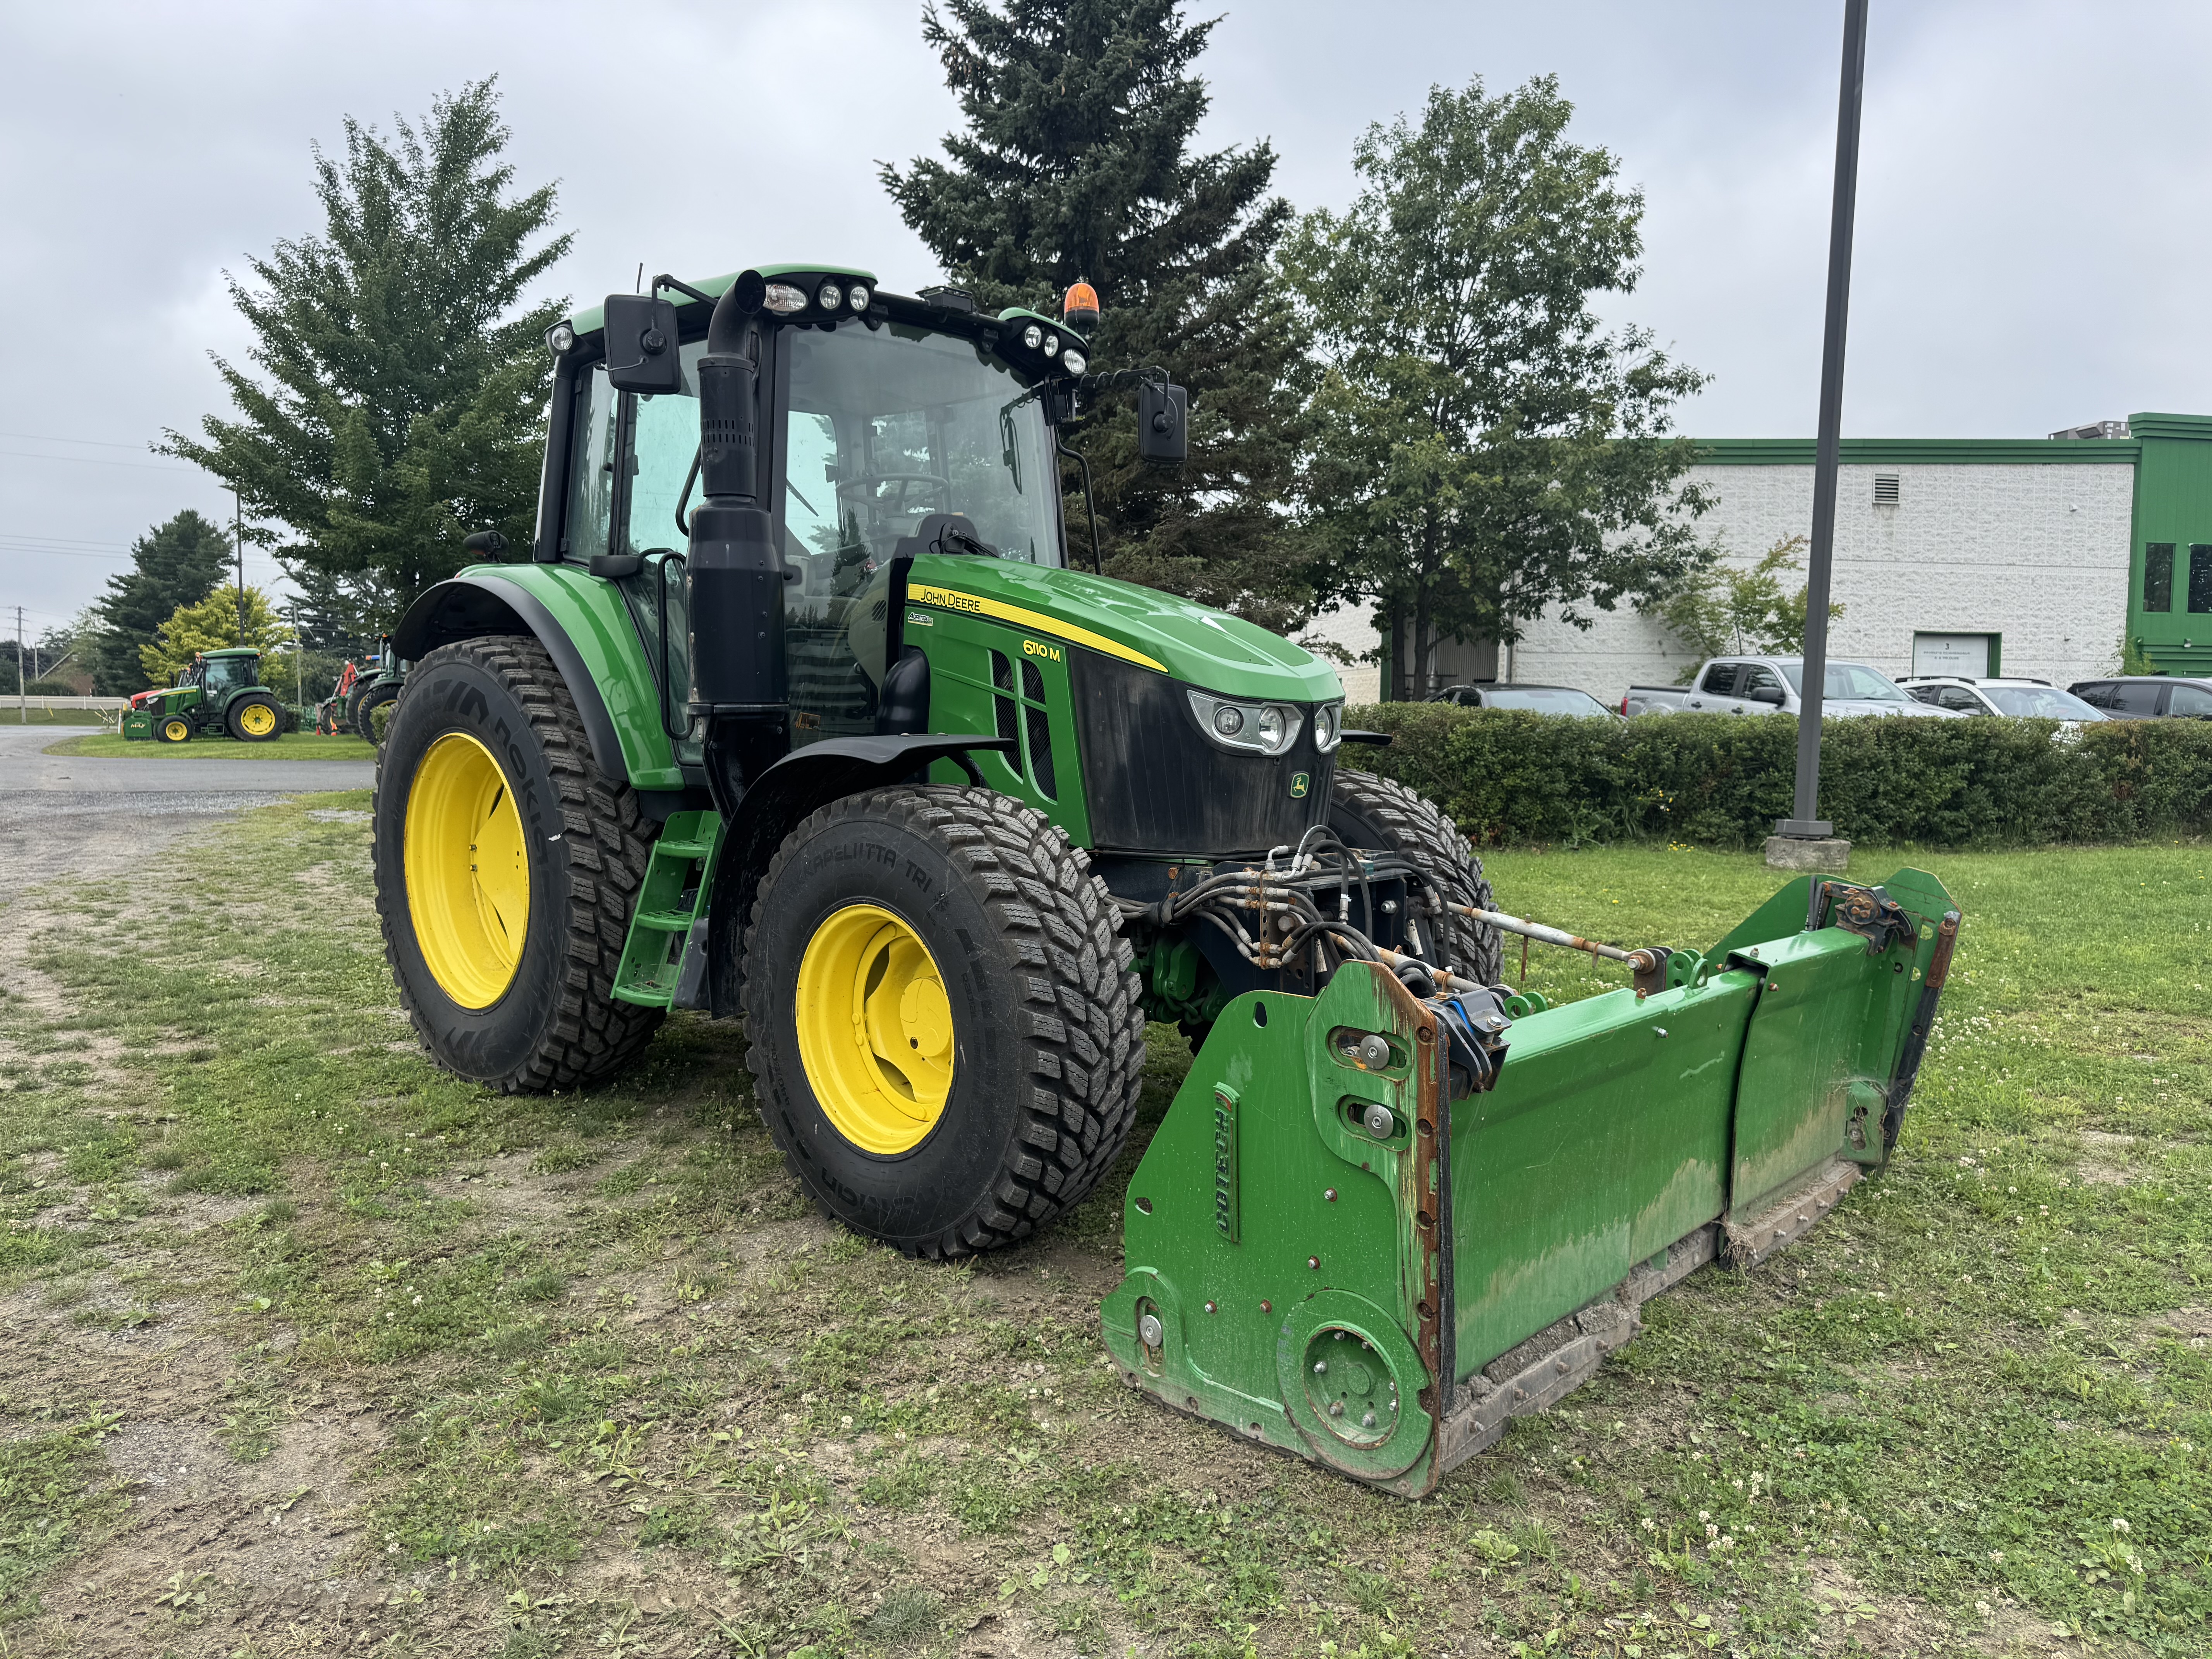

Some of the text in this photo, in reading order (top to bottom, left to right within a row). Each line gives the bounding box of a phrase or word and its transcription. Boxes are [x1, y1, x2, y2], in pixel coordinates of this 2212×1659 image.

[921, 588, 981, 611] JOHN DEERE
[908, 613, 928, 621] AGRITEX
[1023, 640, 1060, 662] 6110 M
[905, 859, 933, 893] TRI
[1214, 1108, 1230, 1233] COTECH
